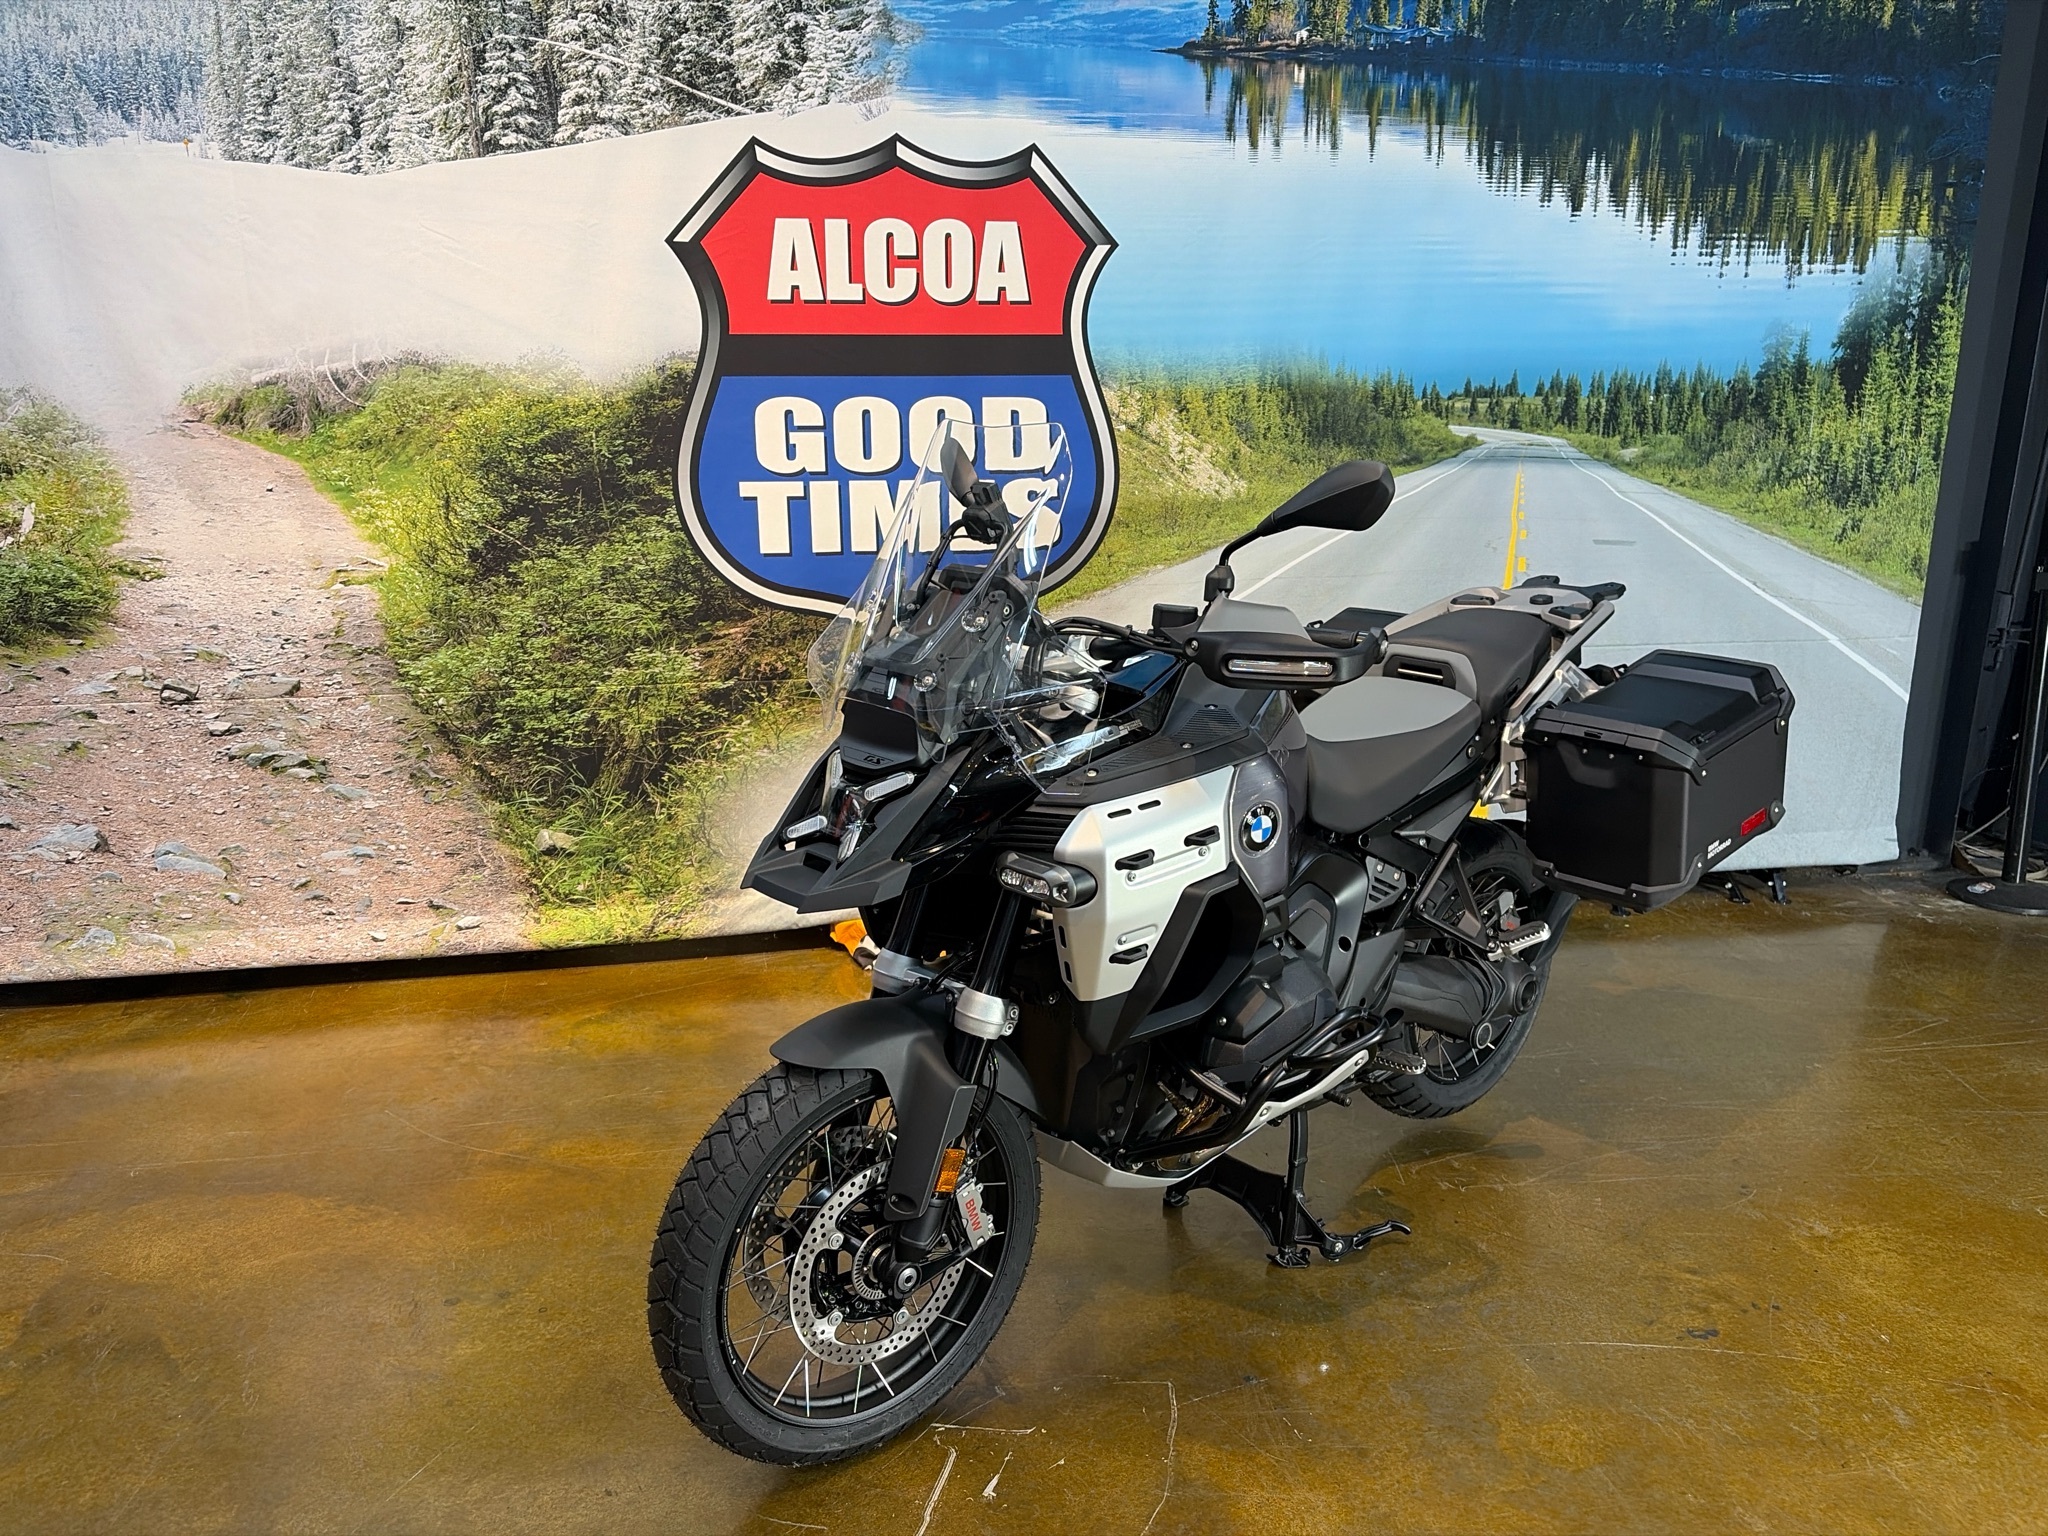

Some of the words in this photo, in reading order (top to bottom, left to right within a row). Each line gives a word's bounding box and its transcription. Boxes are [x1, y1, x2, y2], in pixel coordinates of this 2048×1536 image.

[767, 217, 1030, 304] ALCOA
[754, 396, 1050, 474] GOOD
[965, 1198, 983, 1232] BMW
